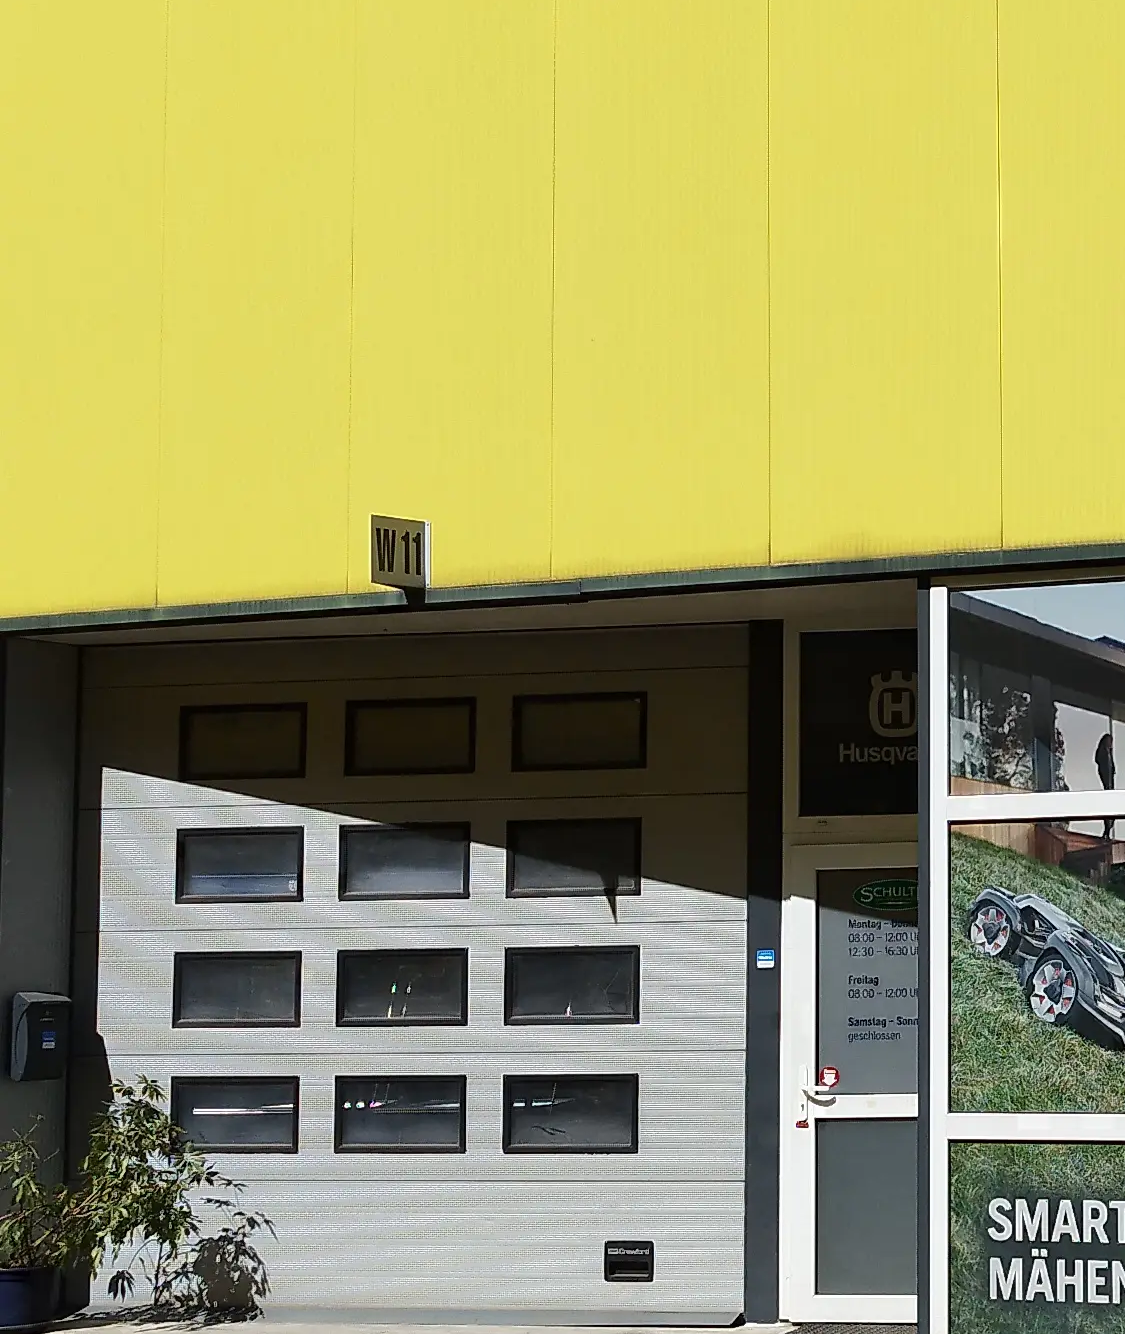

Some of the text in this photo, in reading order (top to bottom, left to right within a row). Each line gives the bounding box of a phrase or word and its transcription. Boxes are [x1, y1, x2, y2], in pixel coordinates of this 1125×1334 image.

[848, 918, 882, 931] Montag
[848, 946, 874, 958] 12:30
[848, 974, 880, 987] Freitag
[848, 1016, 887, 1028] Samstag
[847, 1030, 901, 1043] geschlossen
